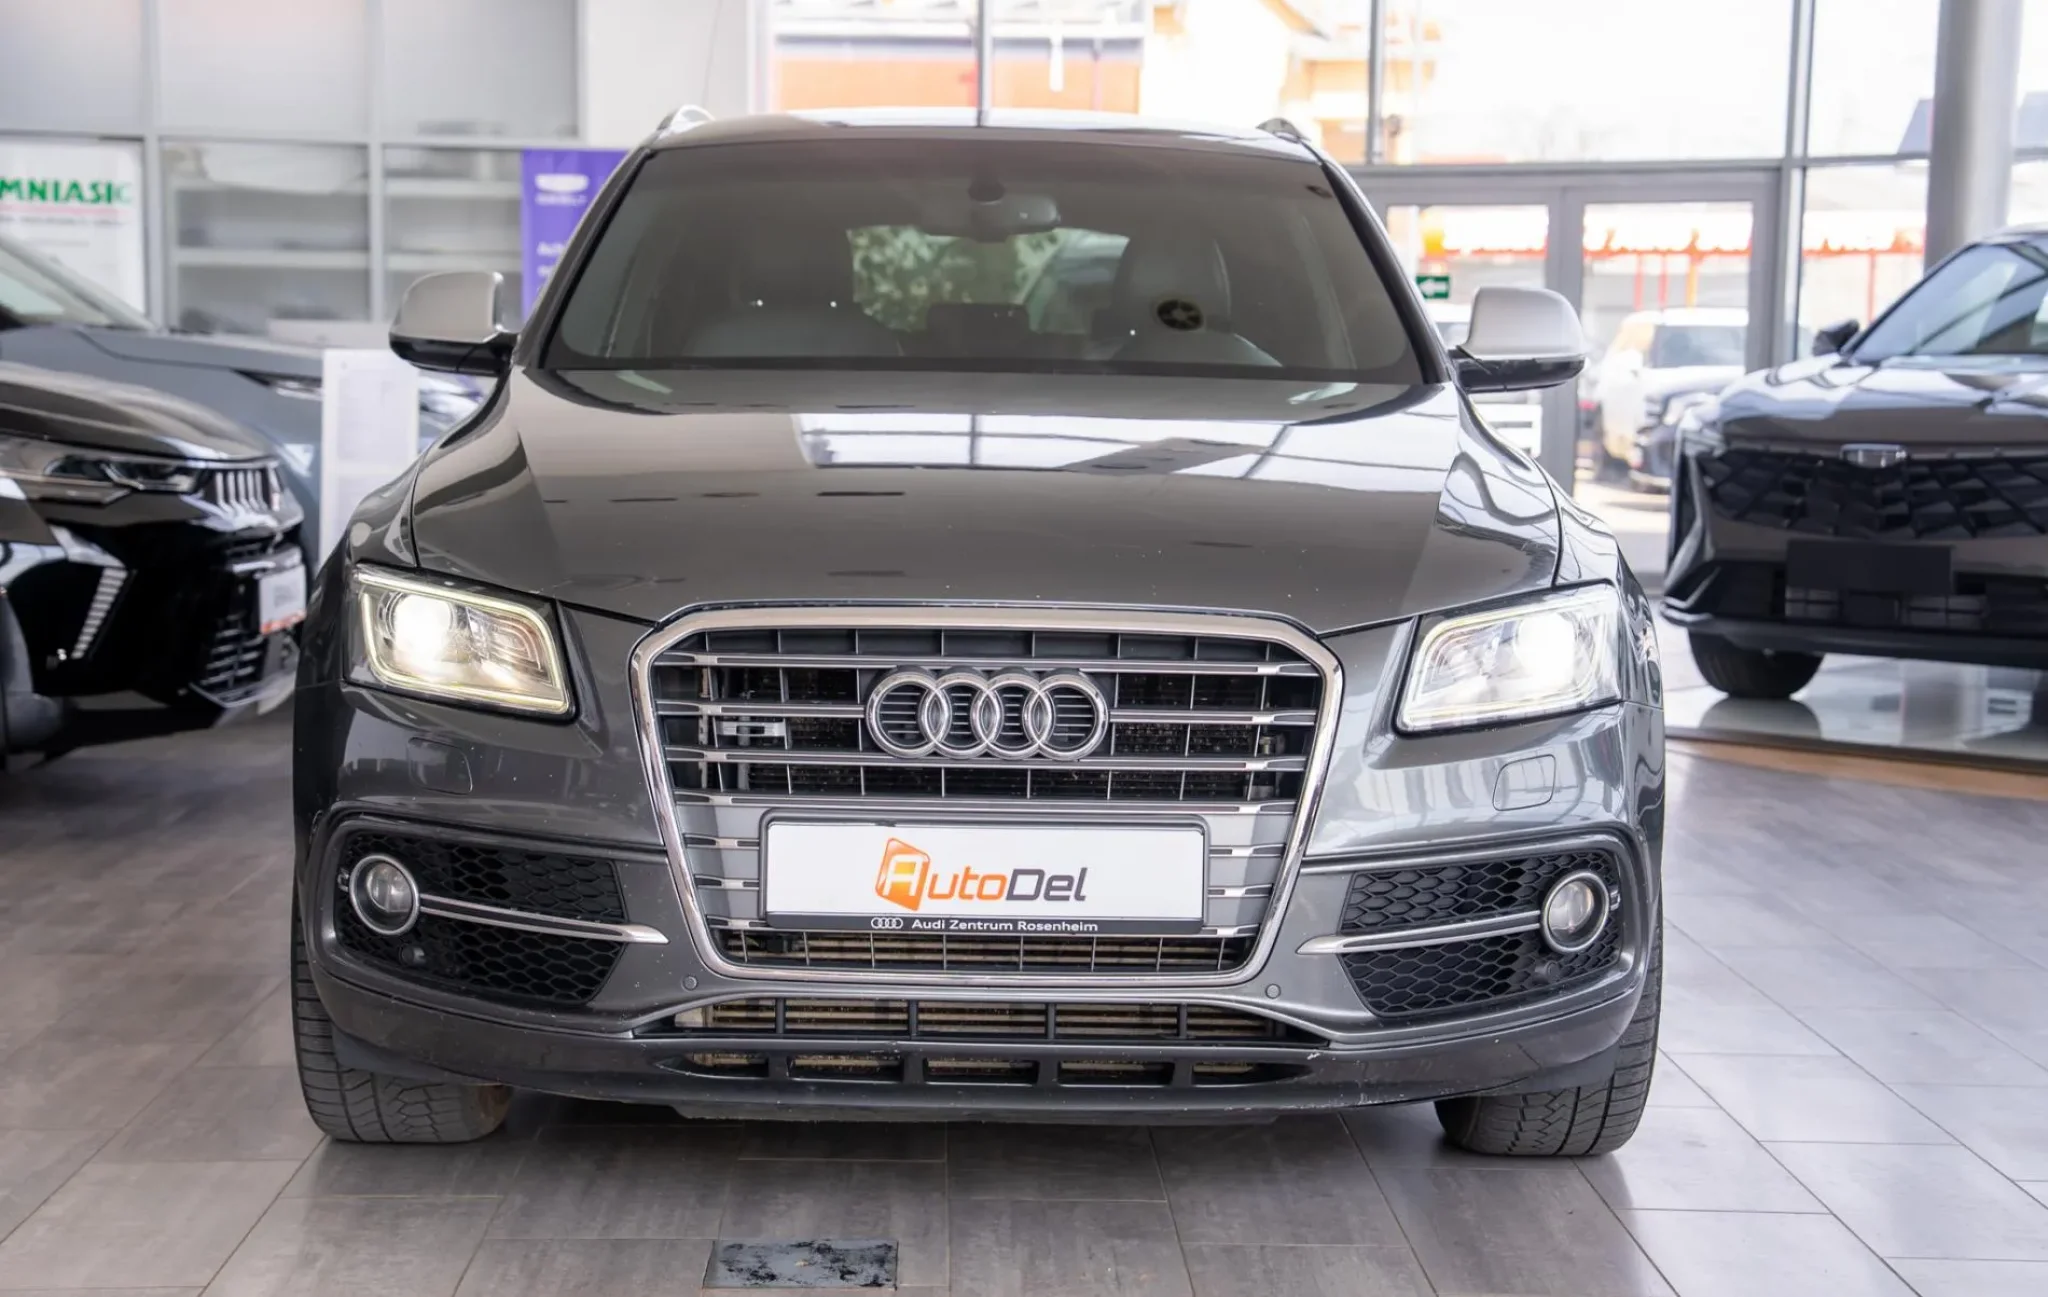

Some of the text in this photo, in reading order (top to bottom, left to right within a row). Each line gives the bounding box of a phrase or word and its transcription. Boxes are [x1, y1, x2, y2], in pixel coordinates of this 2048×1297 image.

[880, 853, 1088, 902] AutoDel
[911, 919, 1098, 932] Audi Zentrum Rosenheim
